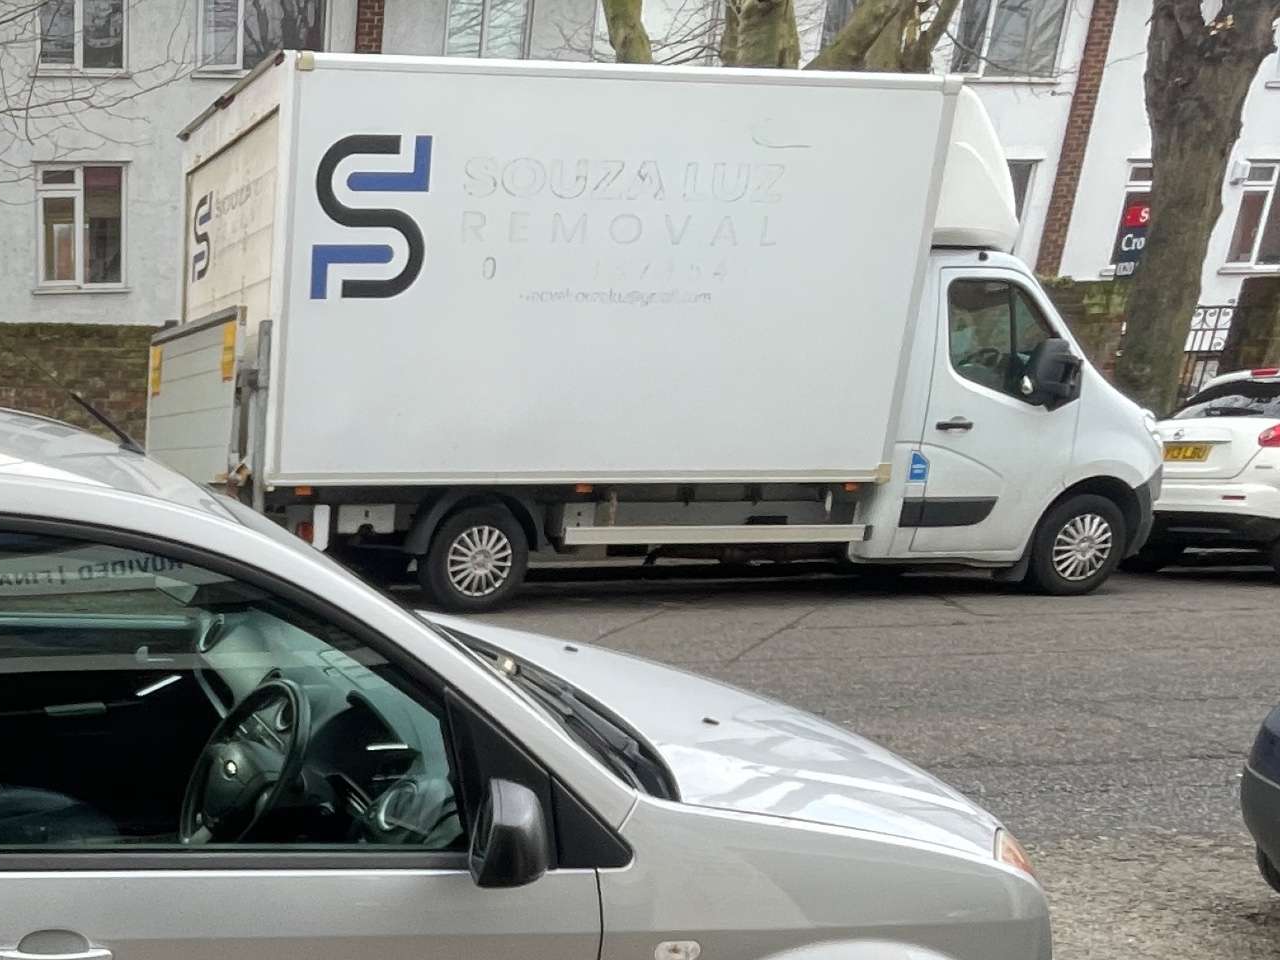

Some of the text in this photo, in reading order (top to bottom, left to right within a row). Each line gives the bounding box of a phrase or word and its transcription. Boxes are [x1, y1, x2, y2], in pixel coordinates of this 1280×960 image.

[463, 156, 787, 203] SOUZA LUZ
[460, 209, 777, 247] REMOVAL
[1121, 233, 1146, 252] Cro
